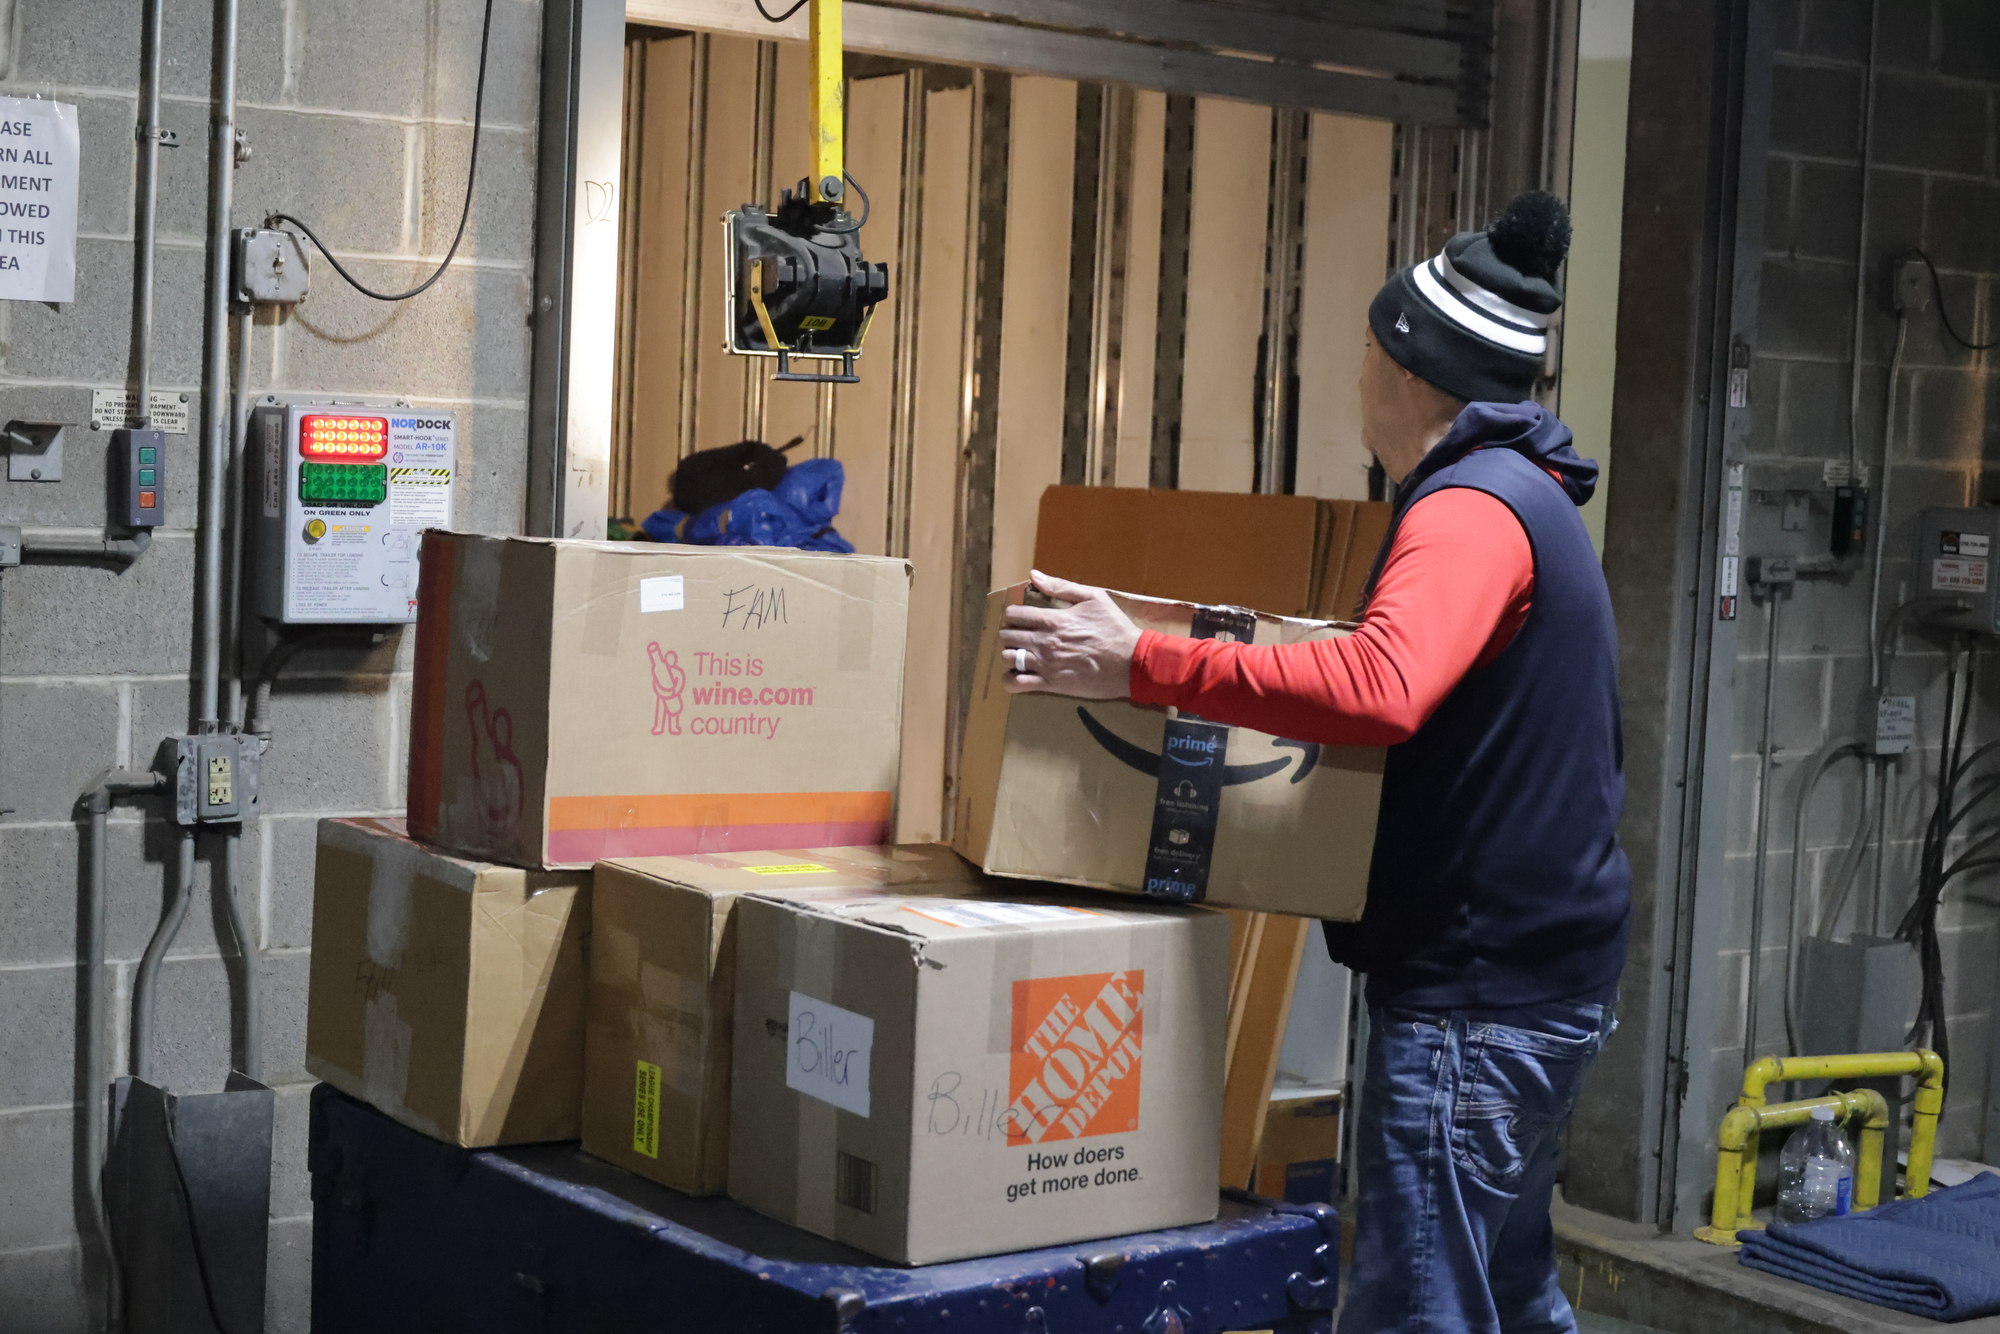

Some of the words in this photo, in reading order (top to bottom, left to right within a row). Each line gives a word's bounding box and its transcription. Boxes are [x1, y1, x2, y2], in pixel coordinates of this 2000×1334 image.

[0, 120, 33, 137] ASE
[22, 150, 54, 166] ALL
[0, 175, 53, 192] MENT
[583, 180, 614, 226] D2
[8, 229, 46, 246] THIS
[804, 318, 828, 328] HOT
[391, 418, 452, 431] NORDOCK
[415, 442, 447, 450] AR-10K
[722, 584, 788, 631] FAM
[693, 652, 742, 677] This
[745, 653, 764, 677] is
[692, 681, 815, 706] wine.com
[690, 712, 781, 740] country
[1167, 735, 1217, 753] prime
[1160, 797, 1175, 806] free
[1176, 800, 1209, 812] listening
[1154, 846, 1169, 854] free
[1170, 849, 1201, 861] delivery
[1147, 876, 1196, 894] prime
[1023, 992, 1081, 1062] THE
[795, 1010, 859, 1086] Biller
[1008, 971, 1144, 1144] HOME
[638, 1070, 648, 1099] SERIES
[648, 1065, 656, 1096] LEAGUE
[1059, 1030, 1143, 1139] DEPOT
[637, 1101, 646, 1119] USE
[927, 1070, 1068, 1141] Biller
[636, 1120, 645, 1144] ONLY
[645, 1097, 655, 1154] CHAMPIONSHIP
[1027, 1152, 1069, 1172] How
[1073, 1145, 1125, 1167] doers
[1006, 1180, 1037, 1203] get
[1042, 1173, 1089, 1194] more
